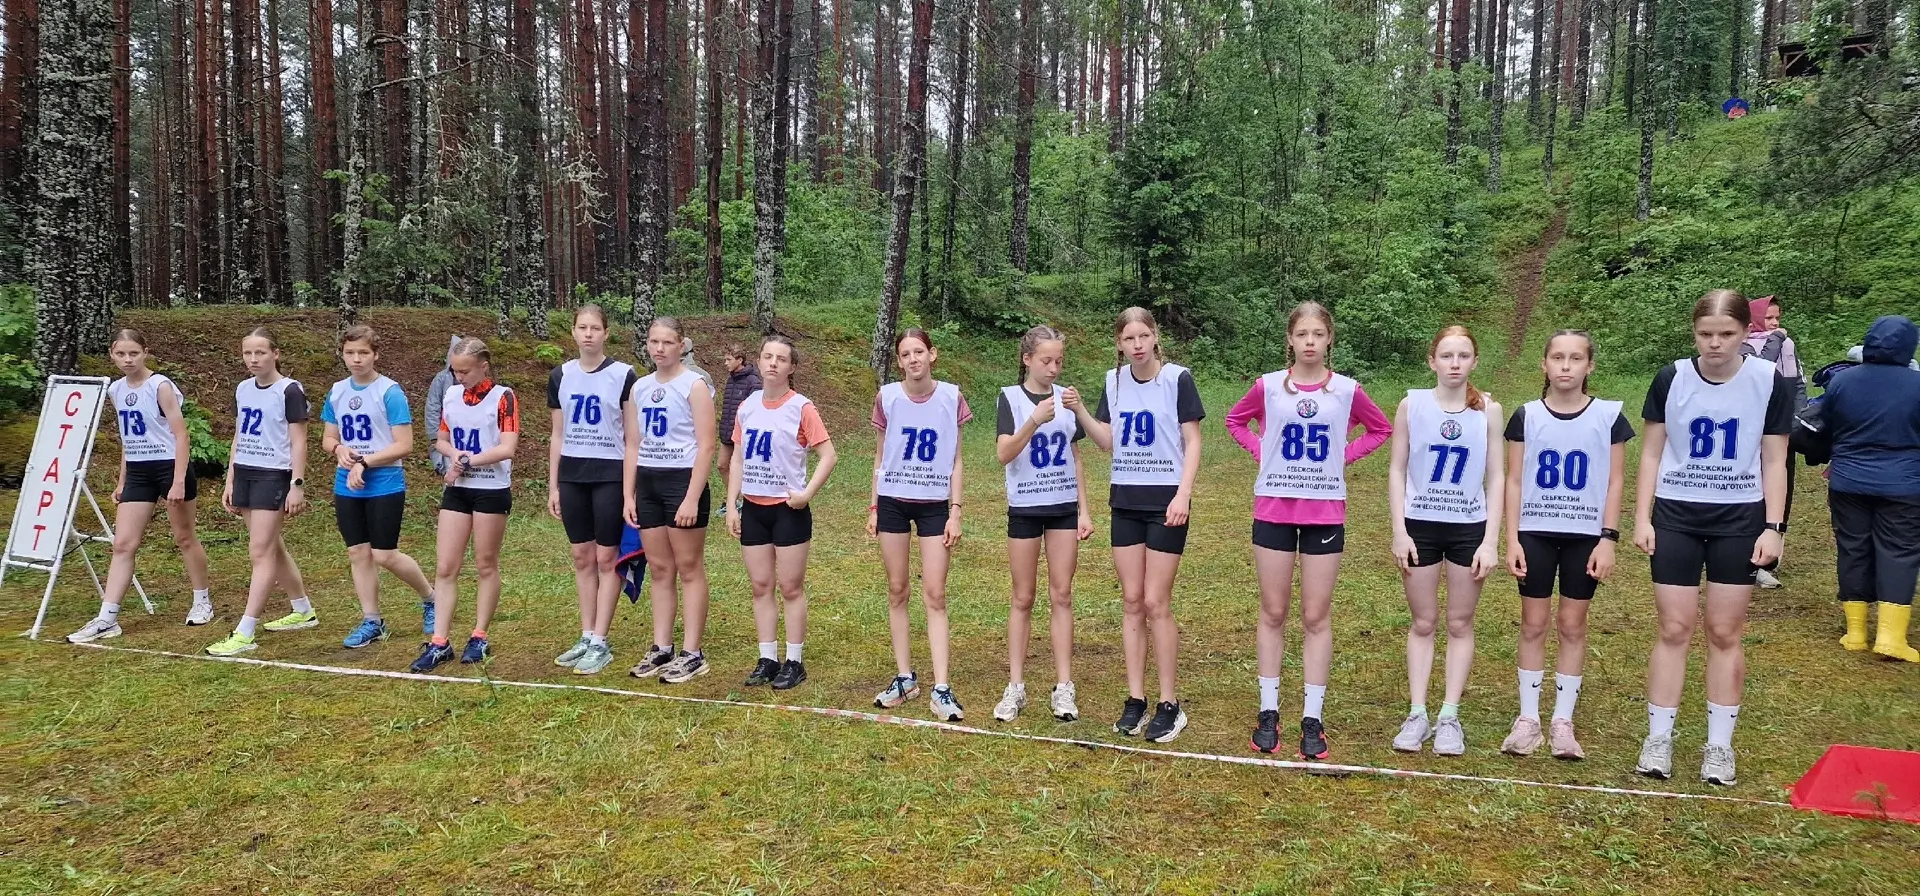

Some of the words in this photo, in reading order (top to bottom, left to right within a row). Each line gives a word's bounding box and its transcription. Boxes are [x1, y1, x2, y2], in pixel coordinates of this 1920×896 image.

[119, 409, 146, 436] 73
[241, 406, 263, 436] 72
[570, 393, 602, 425] 76
[642, 407, 668, 437] 75
[341, 413, 373, 441] 83
[453, 426, 481, 455] 84
[1119, 409, 1155, 448] 79
[1281, 422, 1330, 463] 85
[1689, 416, 1739, 460] 81
[745, 428, 773, 463] 74
[901, 427, 938, 463] 78
[1030, 430, 1068, 469] 82
[32, 391, 82, 550] СТАРТ
[1286, 465, 1323, 473] СЕБЕЖСКИЙ
[1429, 444, 1470, 485] 77
[1535, 448, 1590, 491] 80
[1686, 463, 1733, 473] СЕБЕЖСКИЙ
[1427, 487, 1464, 496] СЕБЕЖСКИЙ
[1541, 494, 1580, 503] СЕБЕЖСКИЙ
[1662, 477, 1708, 489] ФИЗИЧЕСКОЙ
[1709, 482, 1757, 491] ПОДГОТОВКИ
